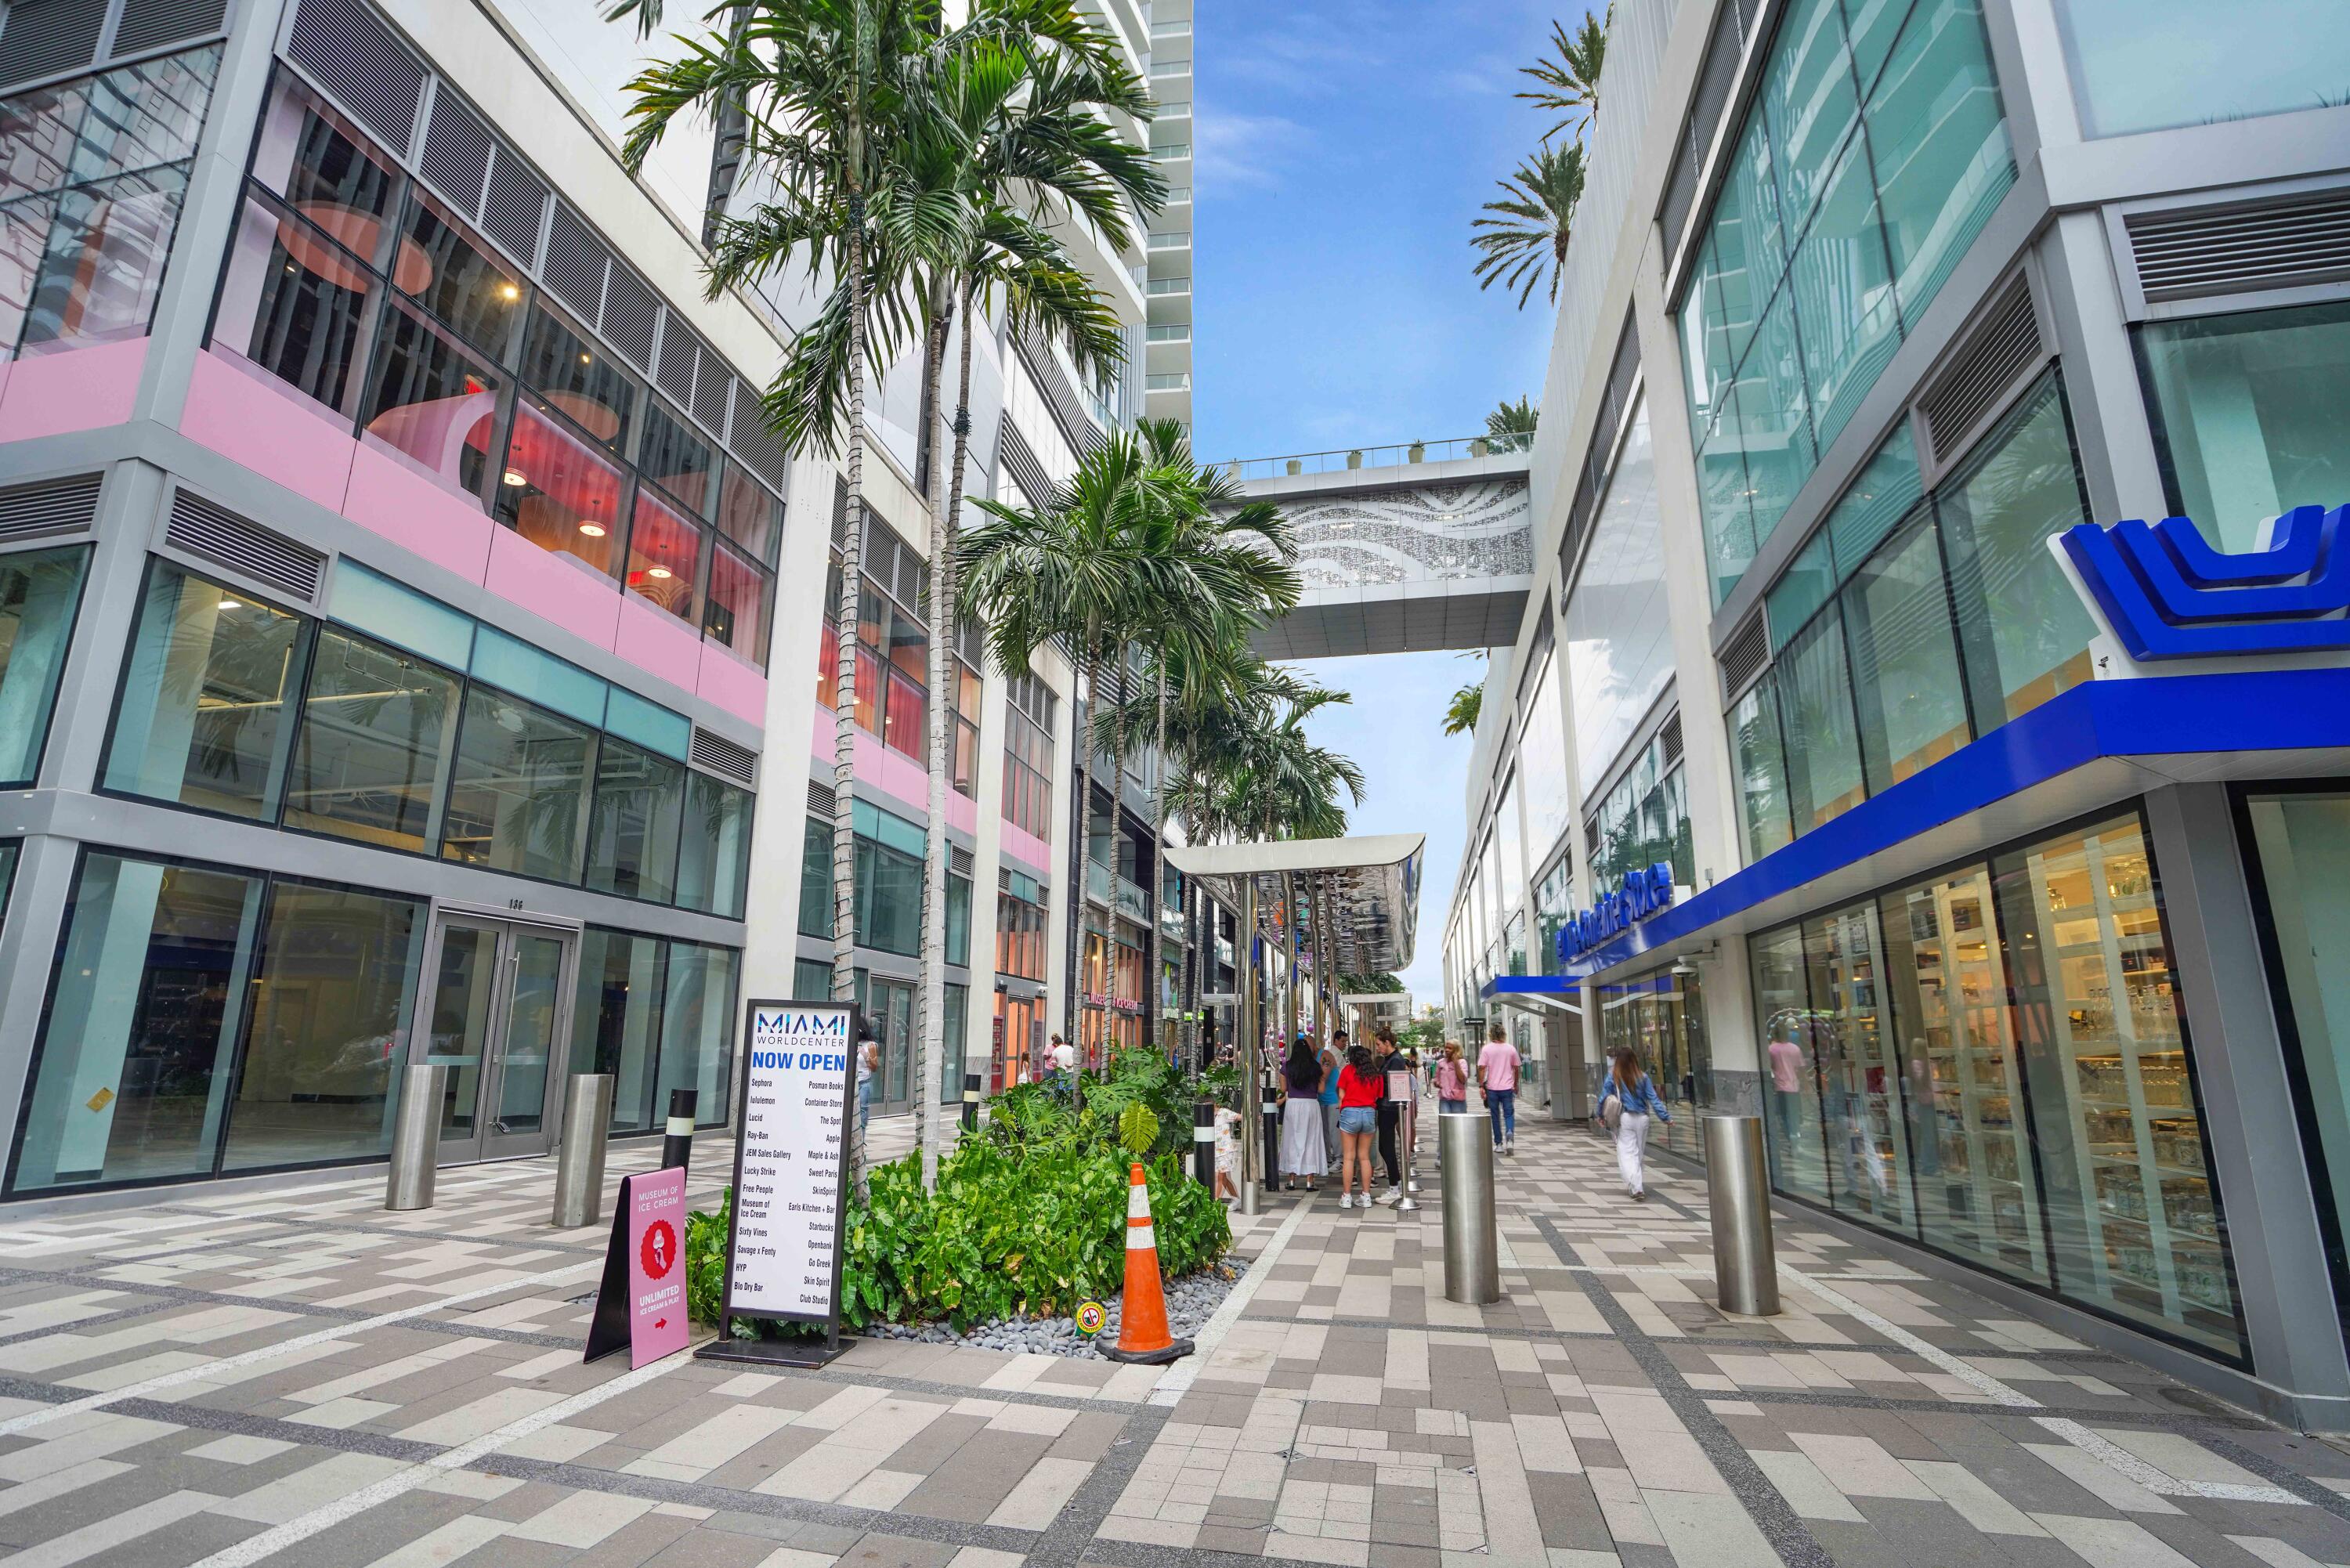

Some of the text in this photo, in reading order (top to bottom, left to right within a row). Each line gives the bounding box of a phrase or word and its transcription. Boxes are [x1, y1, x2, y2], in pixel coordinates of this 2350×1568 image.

[1124, 999, 1138, 1010] CREAM
[757, 1013, 845, 1035] MIAMI
[757, 1036, 844, 1047] WORLDCENTER
[752, 1052, 845, 1071] NOW OPEN
[752, 1078, 772, 1087] Sephora
[808, 1081, 827, 1089] Posman
[750, 1096, 776, 1104] lululemon
[805, 1098, 829, 1107] Container
[747, 1131, 768, 1140] Ray-Ban
[773, 1151, 791, 1160] Gallery
[808, 1151, 823, 1160] Maple
[744, 1167, 760, 1176] Lucky
[808, 1169, 837, 1178] Sweet Paris
[639, 1186, 678, 1201] MUSEUM OF
[743, 1184, 773, 1194] Free People
[812, 1187, 837, 1196] SkinSpirit
[638, 1197, 678, 1212] ICE CREAM
[742, 1198, 764, 1207] Museum
[788, 1203, 801, 1212] Earls
[802, 1204, 821, 1212] Kitchen
[826, 1205, 835, 1213] Bar
[750, 1210, 767, 1219] Cream
[739, 1227, 768, 1237] Sixty Vines
[809, 1222, 833, 1232] Starbucks
[808, 1240, 832, 1250] Openbank
[737, 1245, 757, 1255] Savage
[761, 1247, 776, 1257] Fenty
[816, 1259, 831, 1268] Greek
[815, 1277, 830, 1287] Spirit
[744, 1283, 753, 1292] Dry
[639, 1284, 679, 1306] UNLIMITED
[800, 1295, 829, 1305] Club Studio
[648, 1302, 664, 1313] CREAM
[668, 1295, 680, 1306] PLAY
